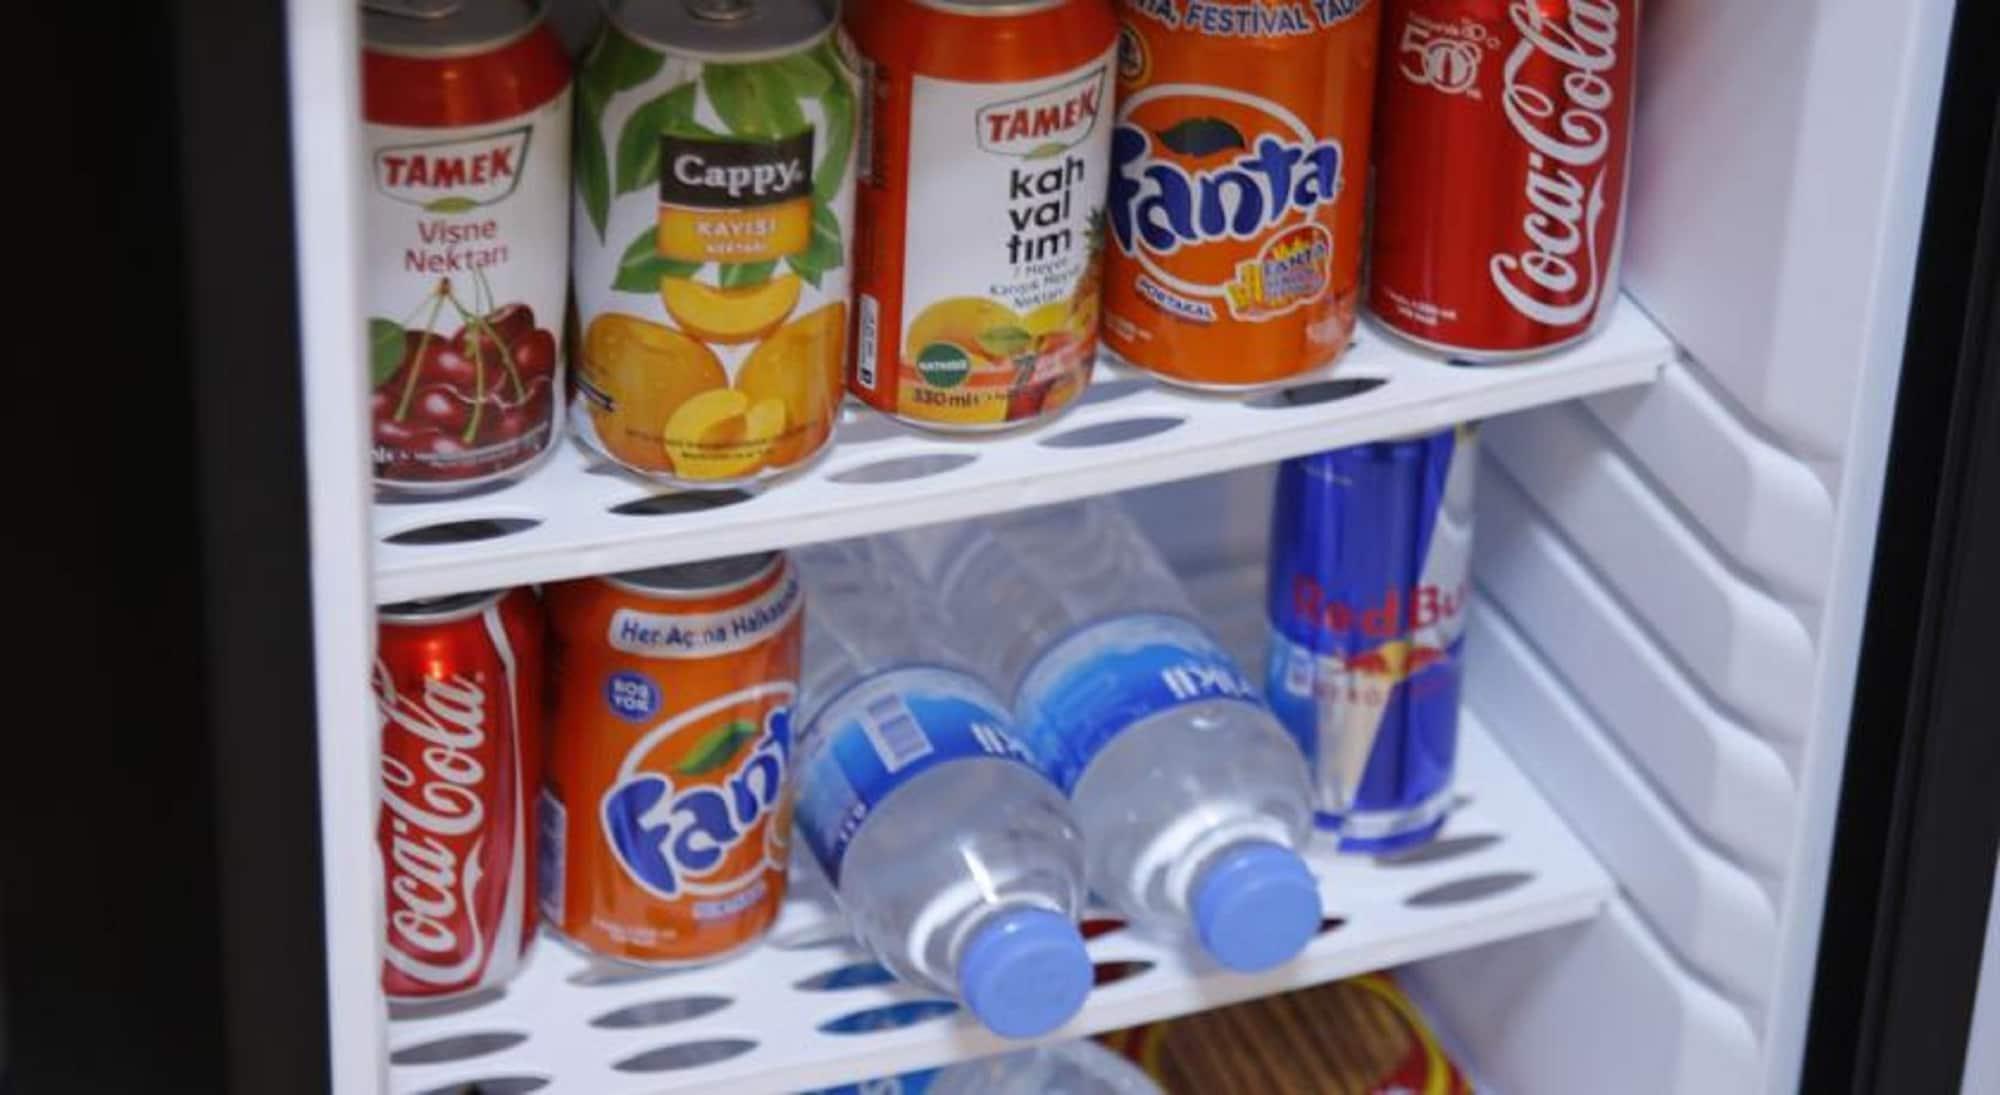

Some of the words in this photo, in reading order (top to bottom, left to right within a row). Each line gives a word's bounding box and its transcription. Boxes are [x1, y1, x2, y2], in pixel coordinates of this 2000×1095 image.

[987, 84, 1097, 143] TAMEK
[384, 146, 513, 188] TAMEK
[674, 154, 799, 197] Cappy
[1010, 155, 1084, 200] kah
[1490, 0, 1618, 325] Coca-Cola
[1009, 190, 1071, 231] val
[1291, 573, 1398, 637] Red
